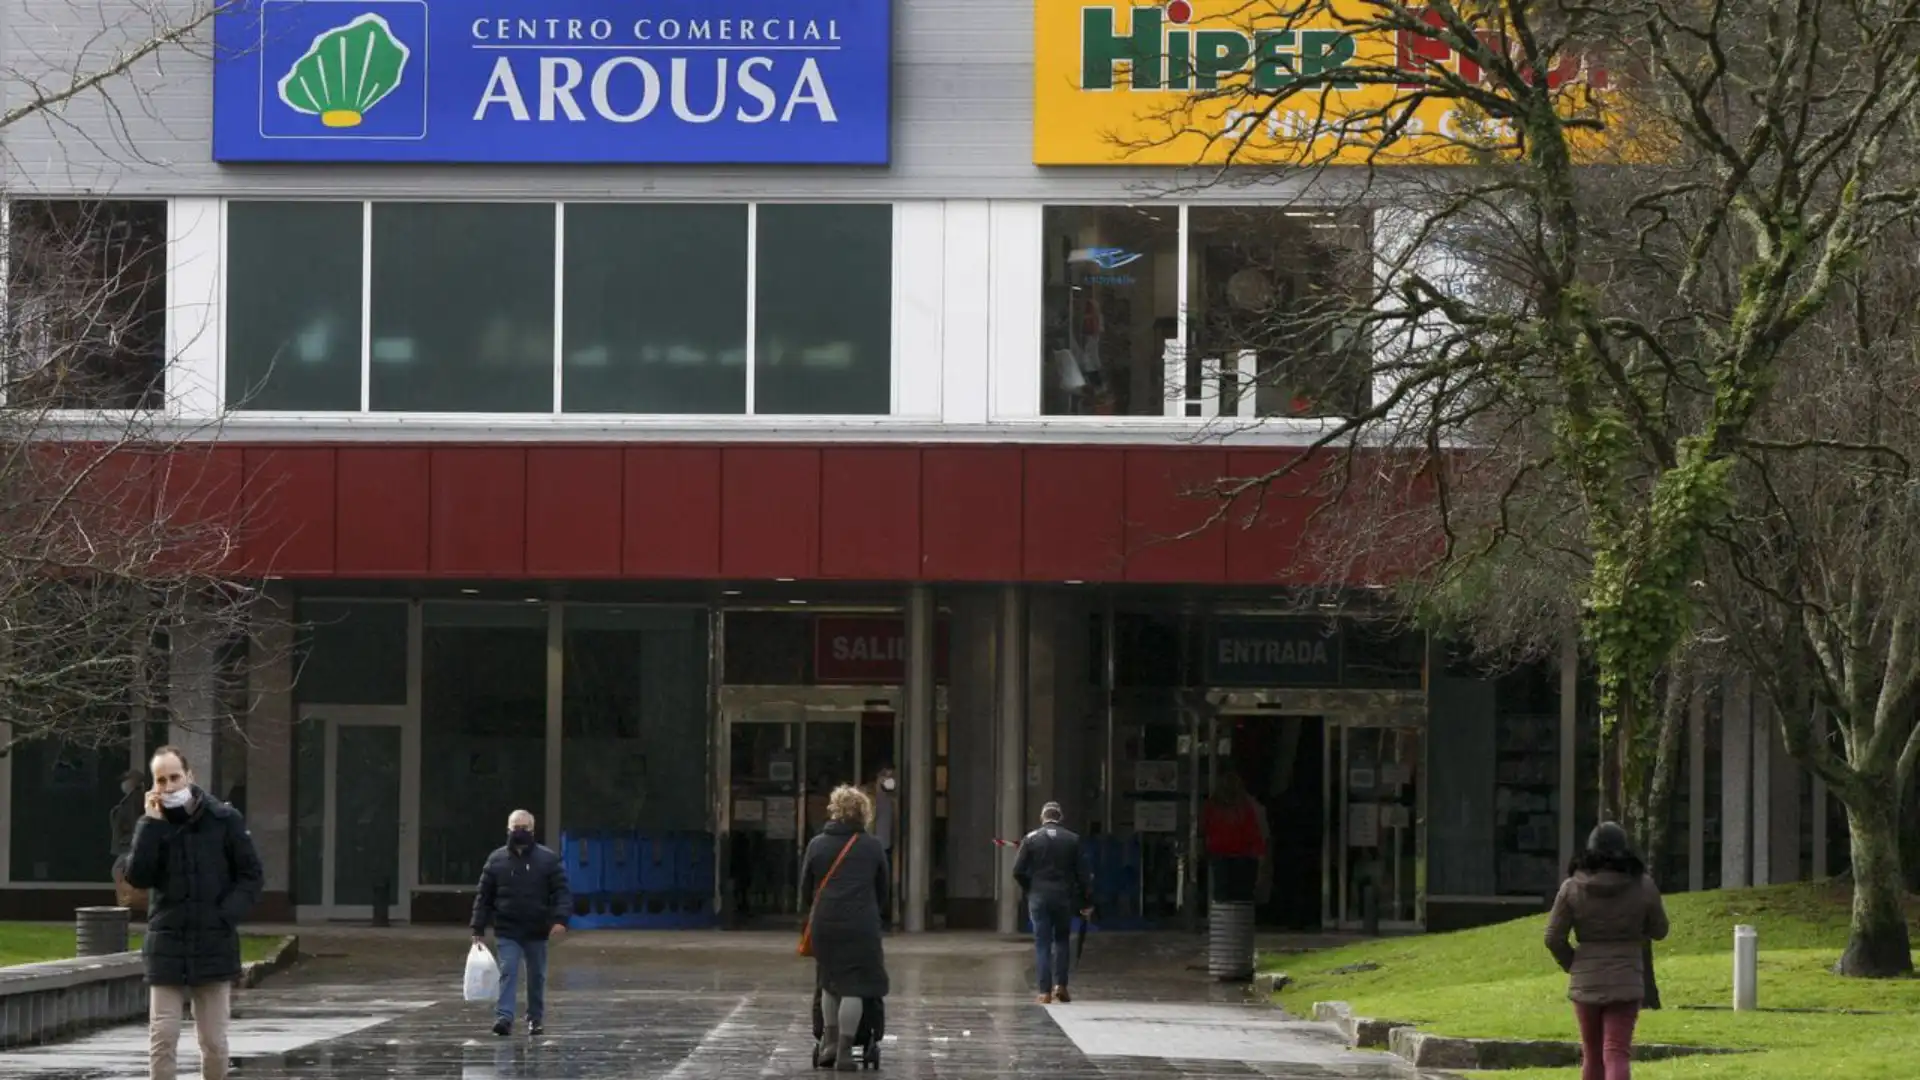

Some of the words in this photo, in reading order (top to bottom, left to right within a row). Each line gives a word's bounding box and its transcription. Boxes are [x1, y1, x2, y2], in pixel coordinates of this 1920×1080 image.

[472, 19, 612, 40] CENTRO
[633, 19, 841, 41] COMERCIAL
[472, 56, 839, 123] AROUSA
[1217, 637, 1328, 664] ENTRADA
